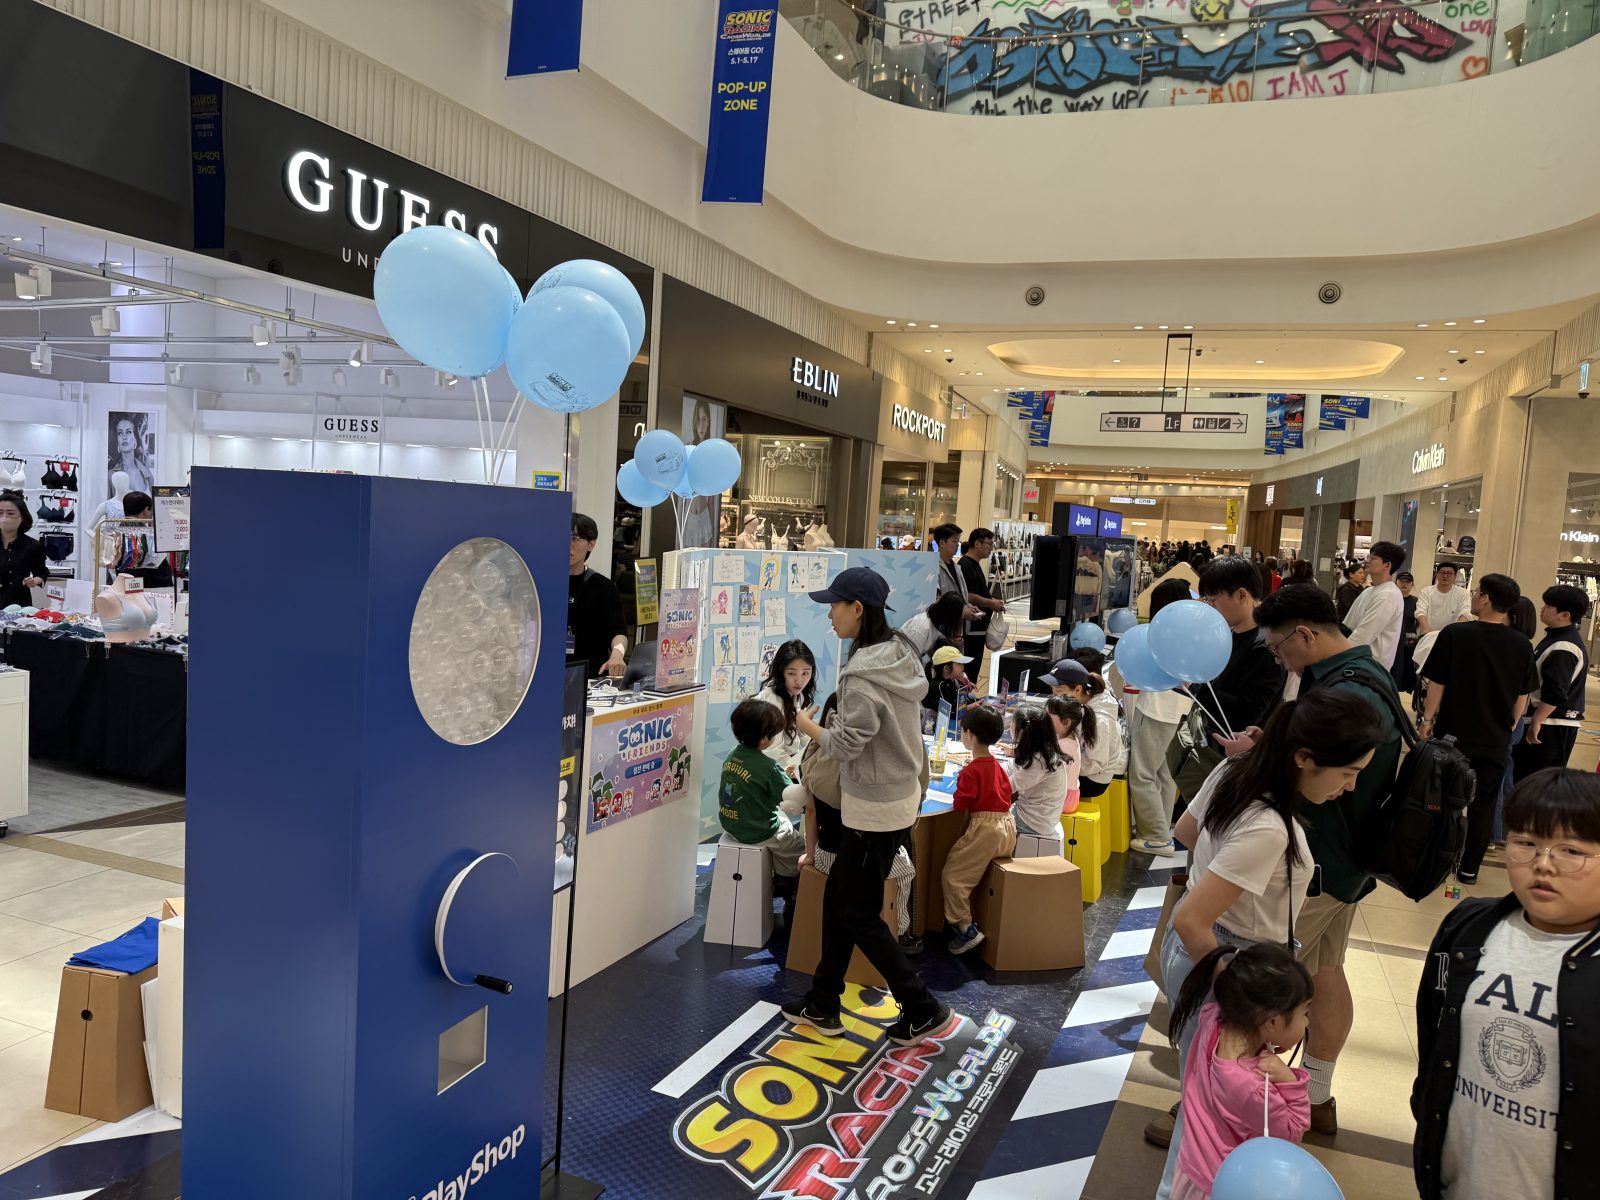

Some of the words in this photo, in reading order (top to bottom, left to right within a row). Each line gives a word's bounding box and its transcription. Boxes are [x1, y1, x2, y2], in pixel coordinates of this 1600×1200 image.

[1445, 1, 1489, 18] one
[727, 10, 773, 25] SONIC
[724, 25, 769, 34] RACING
[718, 81, 767, 94] POP-UP
[724, 99, 758, 111] ZONE
[792, 357, 840, 398] EBLIN
[324, 417, 379, 433] GUESS
[893, 403, 947, 443] ROCKPORT
[1165, 416, 1180, 430] 1F
[1569, 531, 1600, 543] Klein
[666, 610, 693, 623] SONIC
[618, 717, 674, 753] SONIC
[627, 741, 667, 761] FRIENDS
[766, 1012, 970, 1200] RACIN
